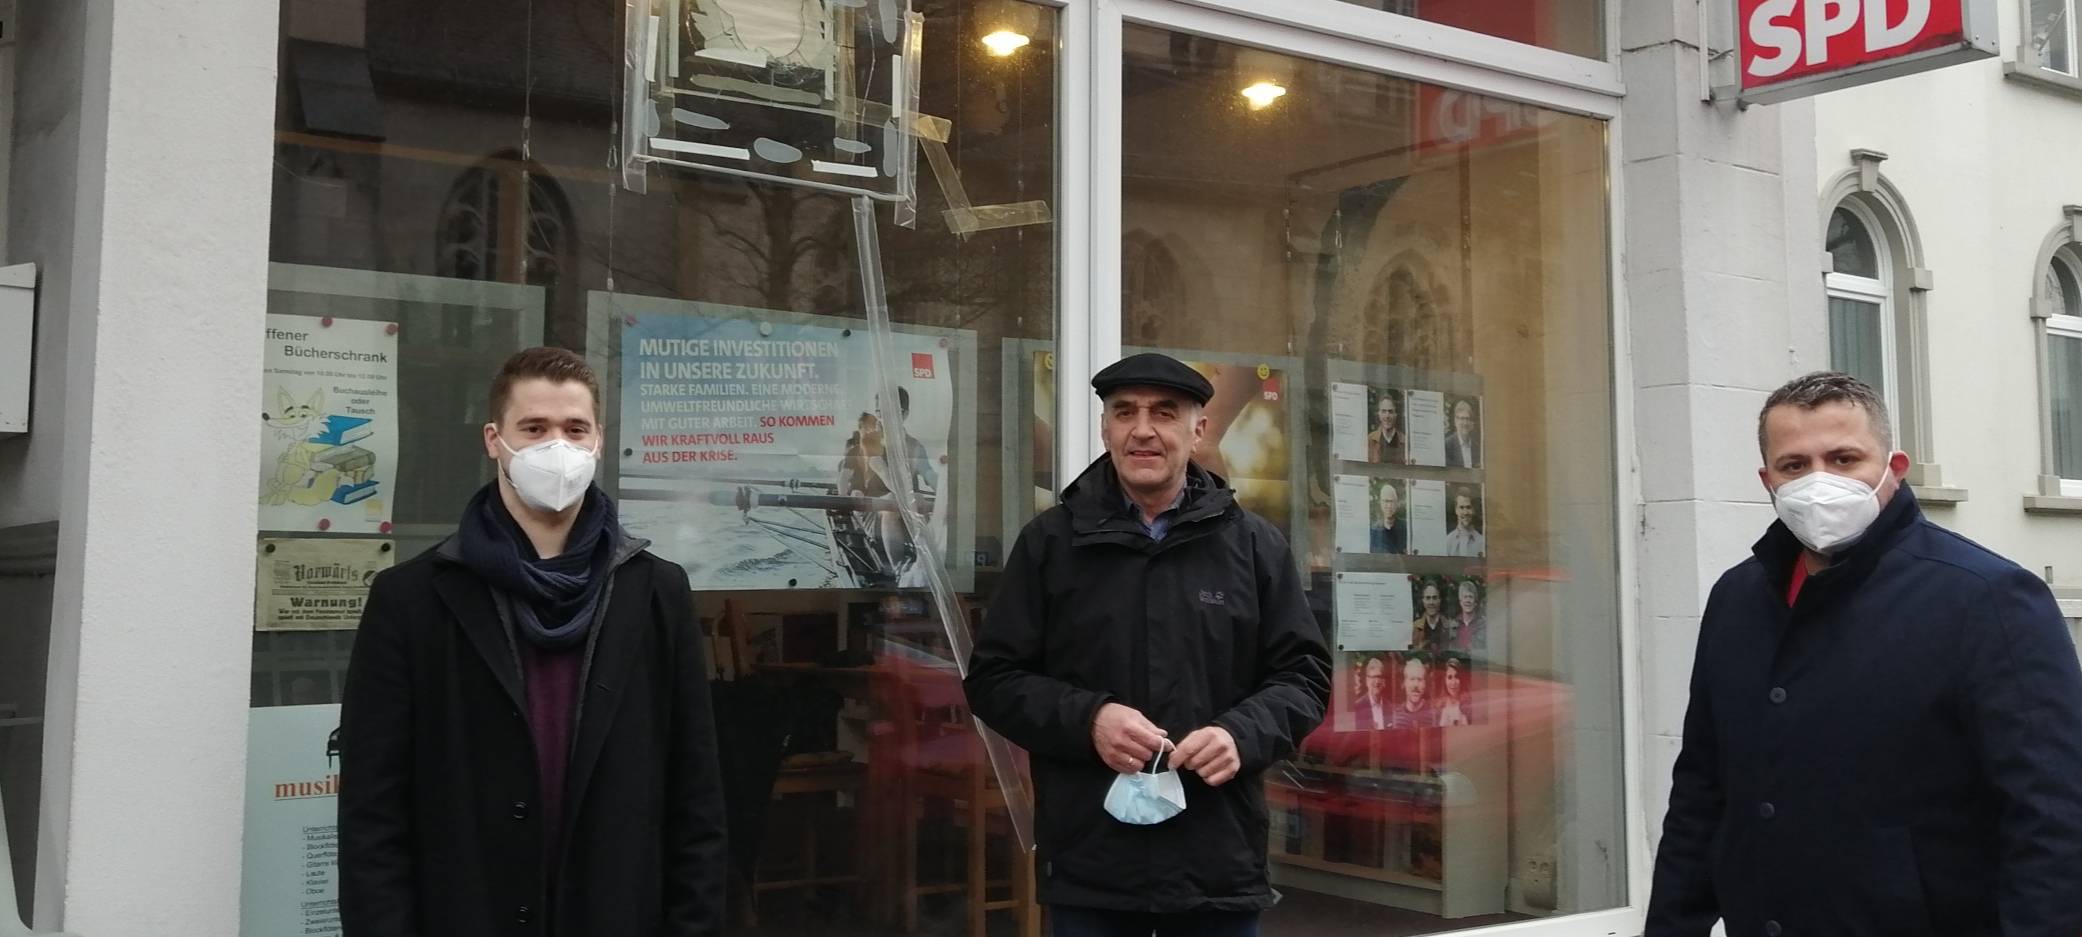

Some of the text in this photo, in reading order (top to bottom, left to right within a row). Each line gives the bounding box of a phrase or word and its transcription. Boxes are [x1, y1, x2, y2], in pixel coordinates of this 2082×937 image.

[1747, 0, 1931, 77] SPD
[266, 328, 309, 341] ffener
[284, 345, 388, 363] Bücherschrank
[640, 338, 840, 357] MUTIGE INVESTITIONEN
[641, 362, 819, 379] IN UNSERE ZUKUNFT.
[914, 367, 932, 377] SPD
[640, 383, 686, 397] STARKE
[688, 383, 750, 396] FAMILIEN.
[751, 383, 779, 396] EINE
[641, 417, 666, 431] MIT
[668, 416, 710, 430] GUTER
[759, 415, 777, 428] SO
[780, 415, 835, 428] KOMMEN
[641, 432, 775, 447] WIR KRAFTVOLL RAUS
[642, 449, 738, 464] AUS DER KRISE.
[290, 597, 362, 608] Warnung!
